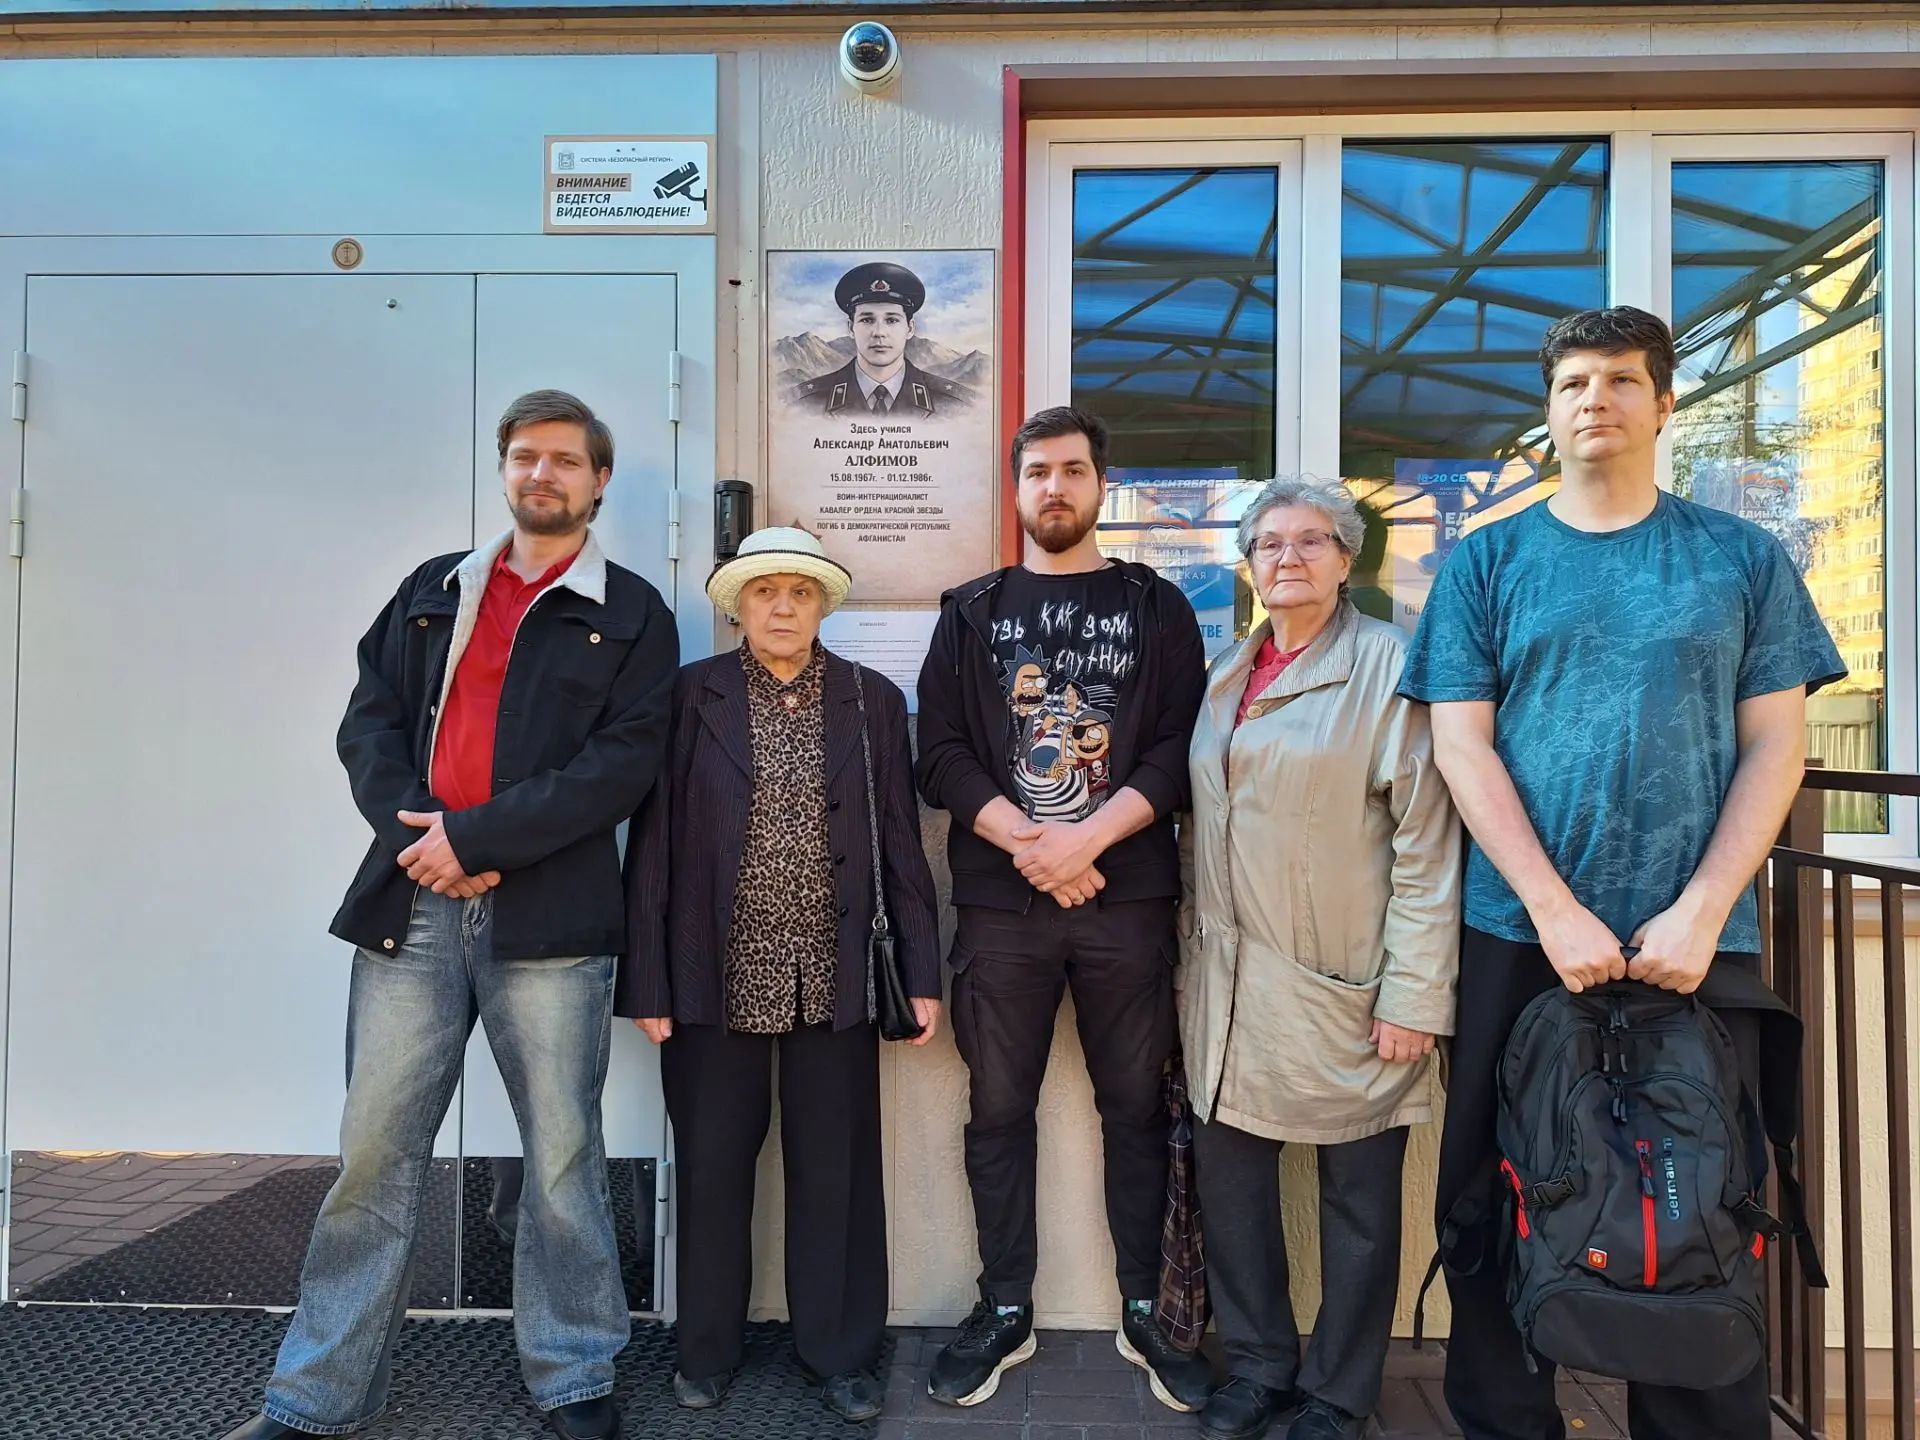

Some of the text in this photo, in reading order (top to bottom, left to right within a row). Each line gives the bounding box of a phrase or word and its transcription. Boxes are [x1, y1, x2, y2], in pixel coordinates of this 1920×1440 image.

[556, 177, 628, 188] ВНИМАНИЕ
[556, 193, 611, 205] ВЕДЕТСЯ
[556, 206, 691, 218] ВИДЕОНАБЛЮДЕНИЕ!
[845, 455, 918, 467] АЛФИМОВ
[830, 473, 878, 482] 15.08.1967г.
[887, 473, 934, 482] 01.12.1986г.
[836, 493, 928, 501] ВОИН-ИНТЕРНАЦИОНАЛИСТ
[854, 507, 882, 515] ОРДЕНА
[884, 506, 915, 514] КРАСНОЙ
[847, 522, 909, 530] ДЕМОКРАТИЧЕСКОЙ
[858, 535, 906, 543] АФГАНИСТАН
[1200, 625, 1222, 638] ТВЕ
[1661, 1136, 1679, 1220] Germanium
